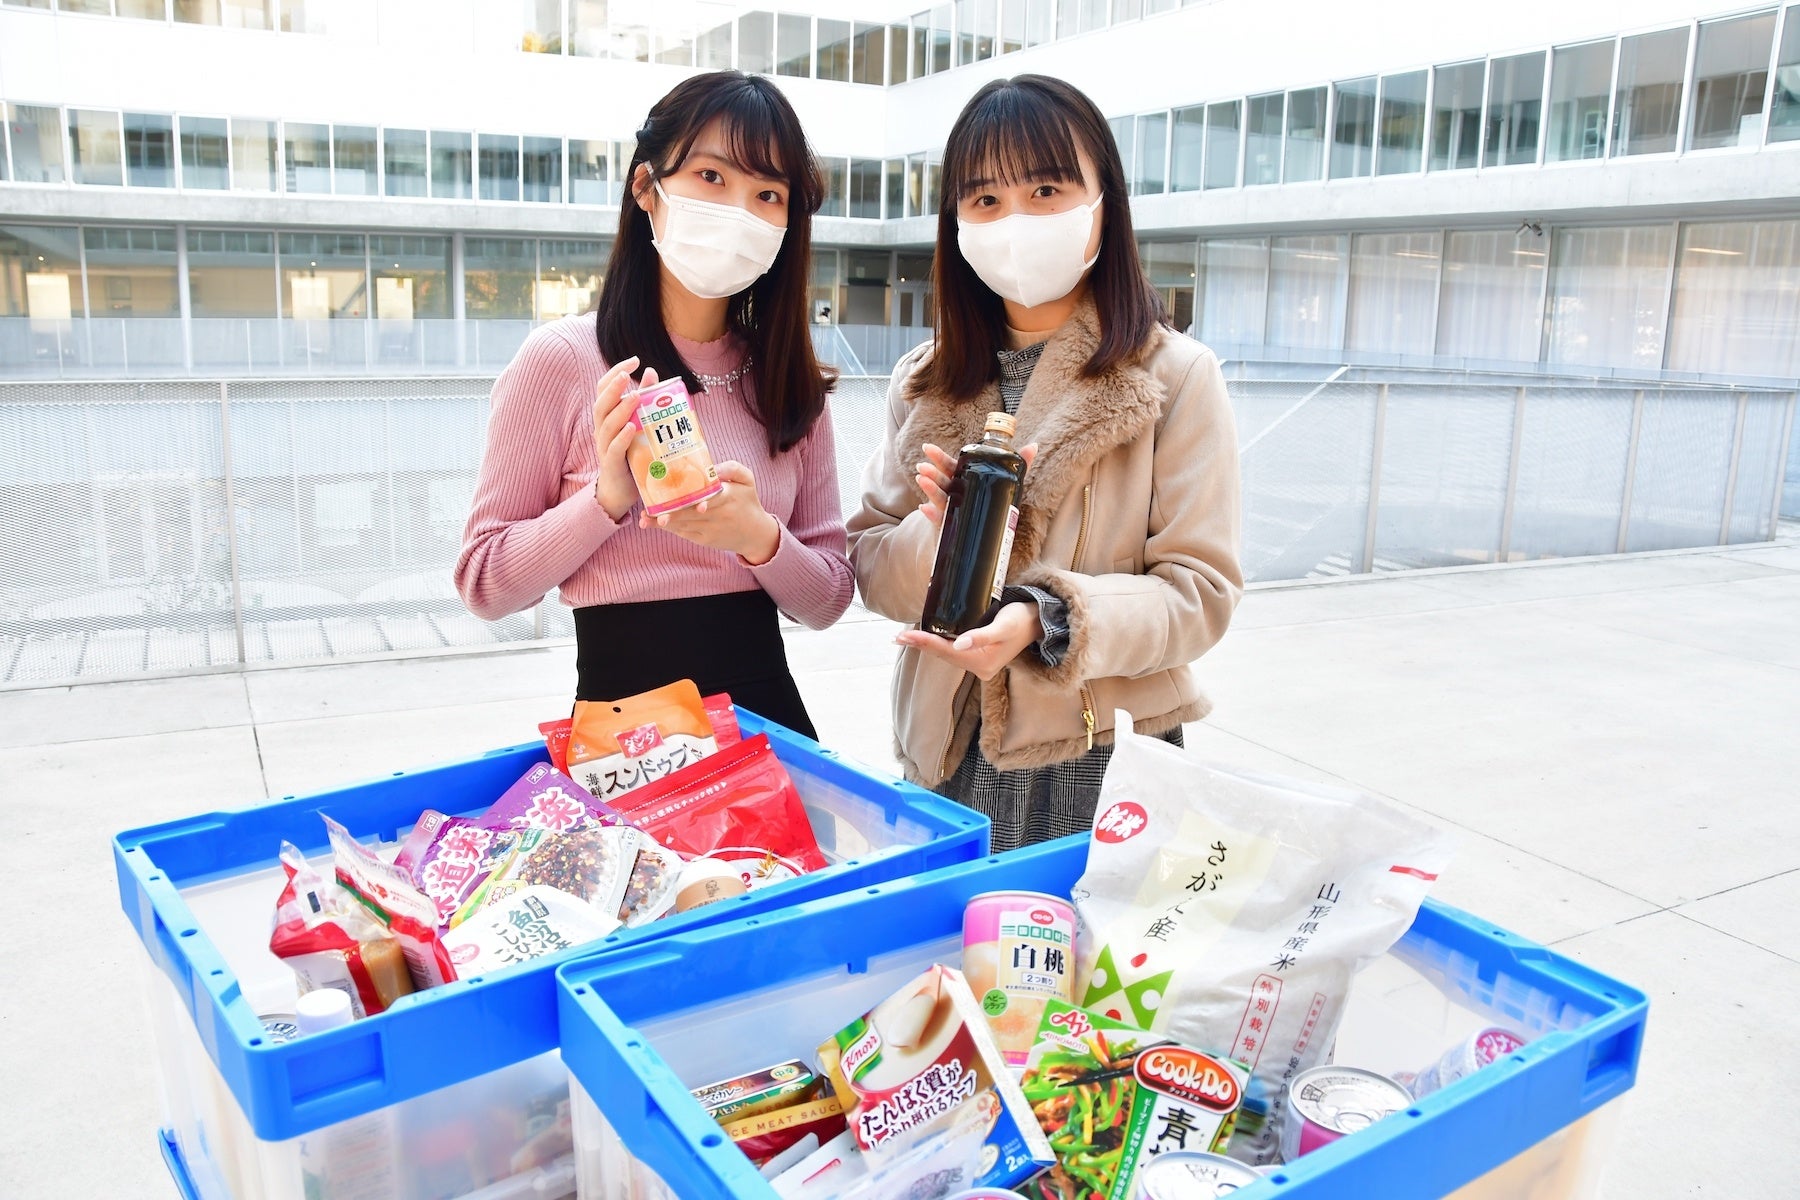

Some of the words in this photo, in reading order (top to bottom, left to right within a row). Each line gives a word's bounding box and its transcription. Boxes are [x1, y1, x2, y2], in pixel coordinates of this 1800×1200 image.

[655, 416, 692, 444] 白桃
[1269, 883, 1341, 971] 山形県産米
[1013, 944, 1064, 975] 白桃
[1027, 974, 1053, 985] 2つ割り
[845, 1035, 877, 1071] Knorr
[862, 1061, 960, 1136] たんぱく質が
[757, 1115, 793, 1131] MEAT
